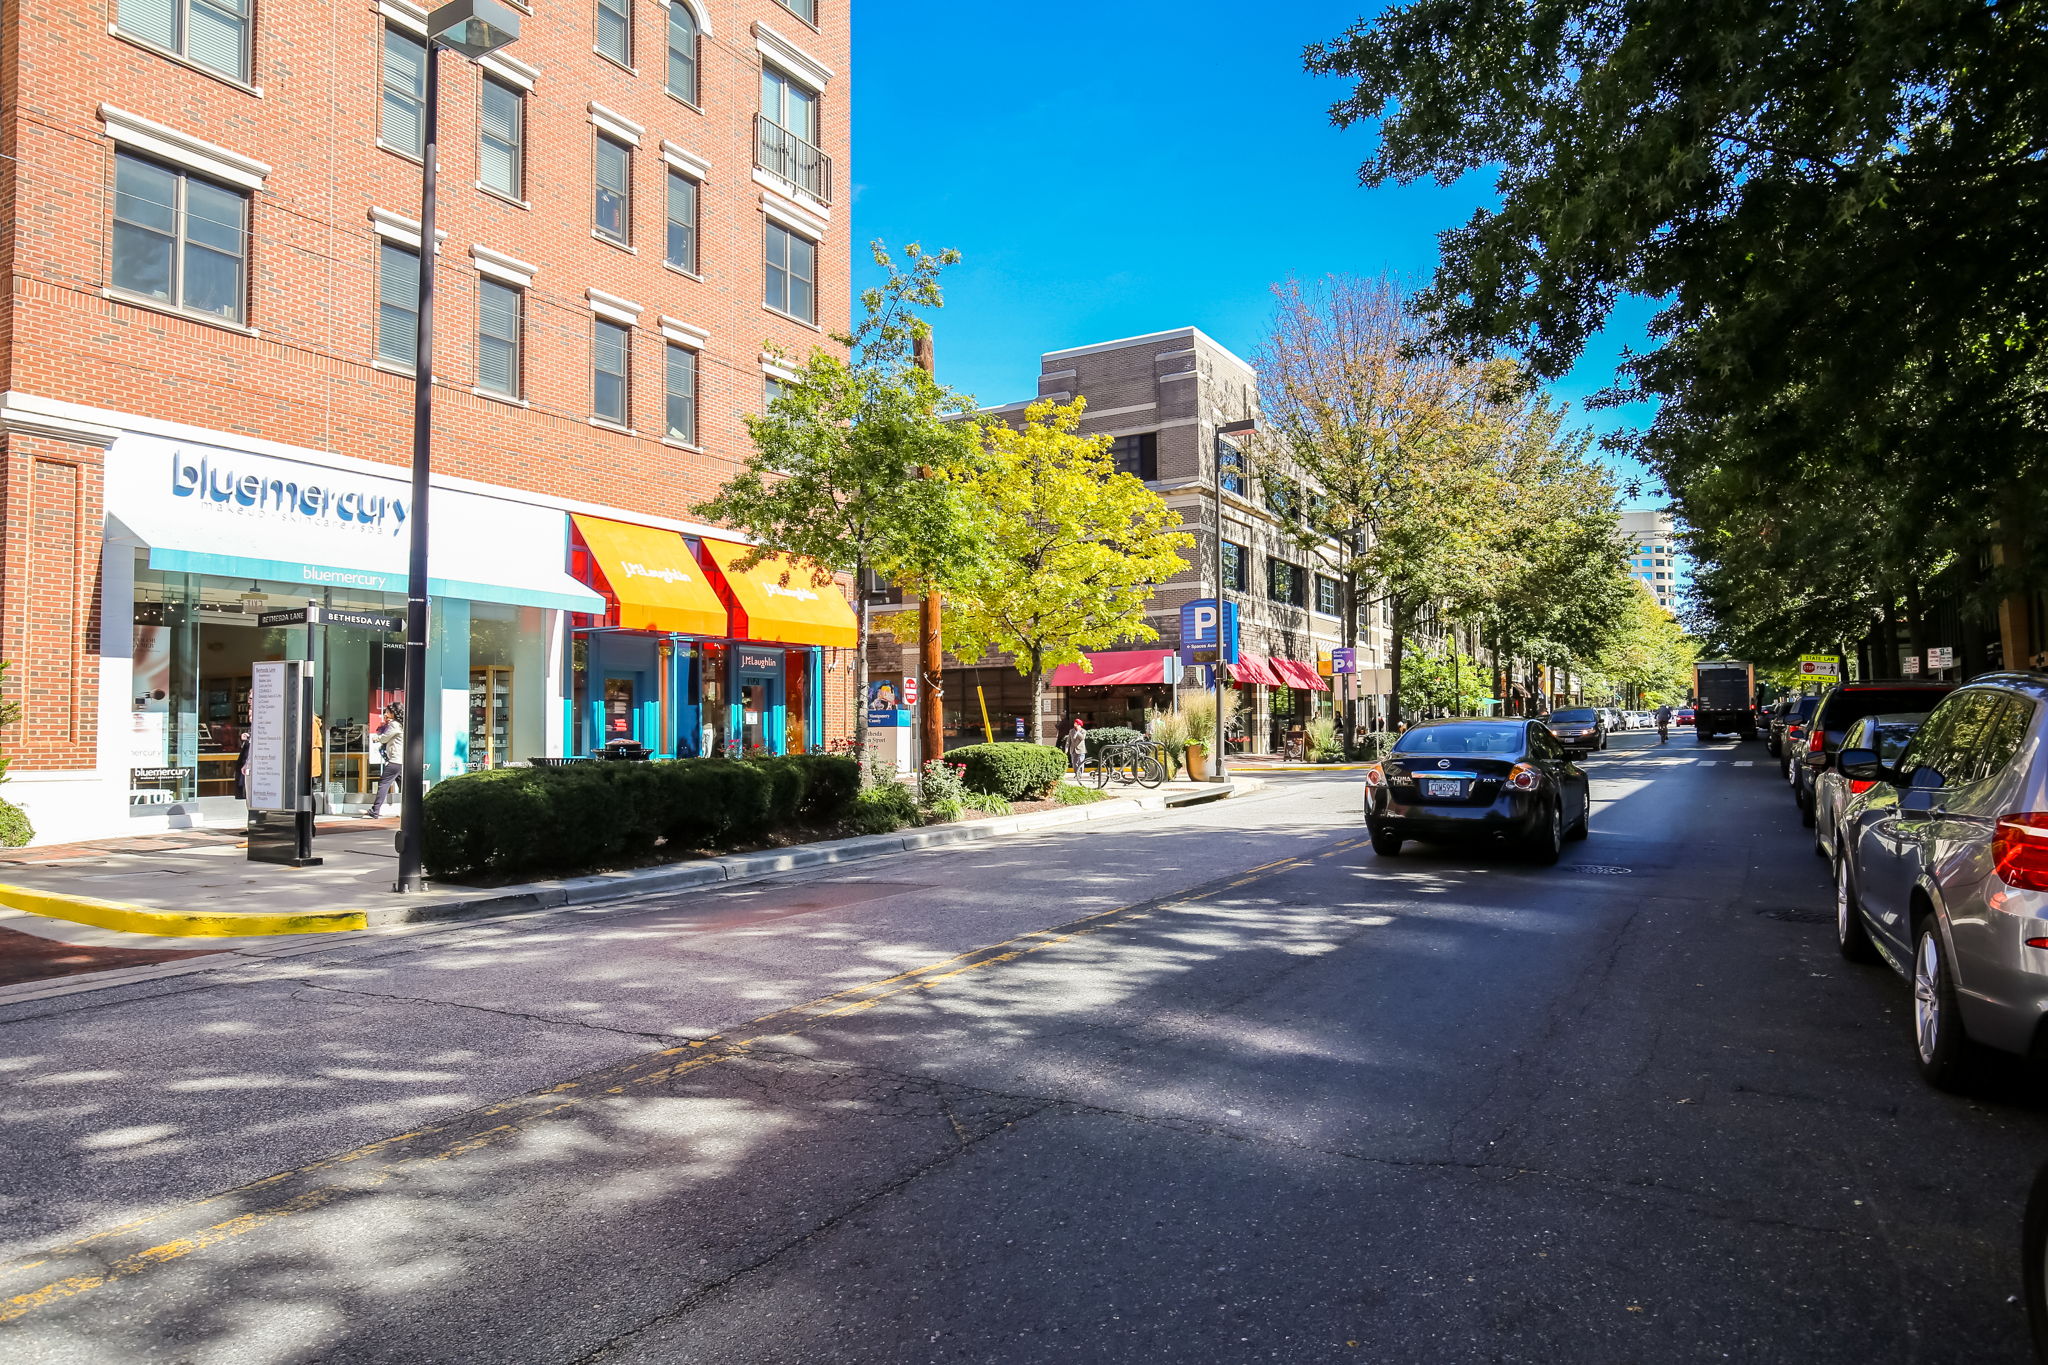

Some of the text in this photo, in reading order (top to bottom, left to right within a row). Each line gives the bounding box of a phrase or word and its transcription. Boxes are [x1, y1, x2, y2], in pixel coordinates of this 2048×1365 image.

[172, 449, 411, 537] bluemercury
[303, 565, 386, 589] bluemercury
[328, 613, 391, 628] BETHESDA AVE
[1194, 606, 1217, 640] P
[383, 642, 406, 650] CHANEL
[1333, 659, 1346, 672] P
[134, 767, 191, 777] bluemercury
